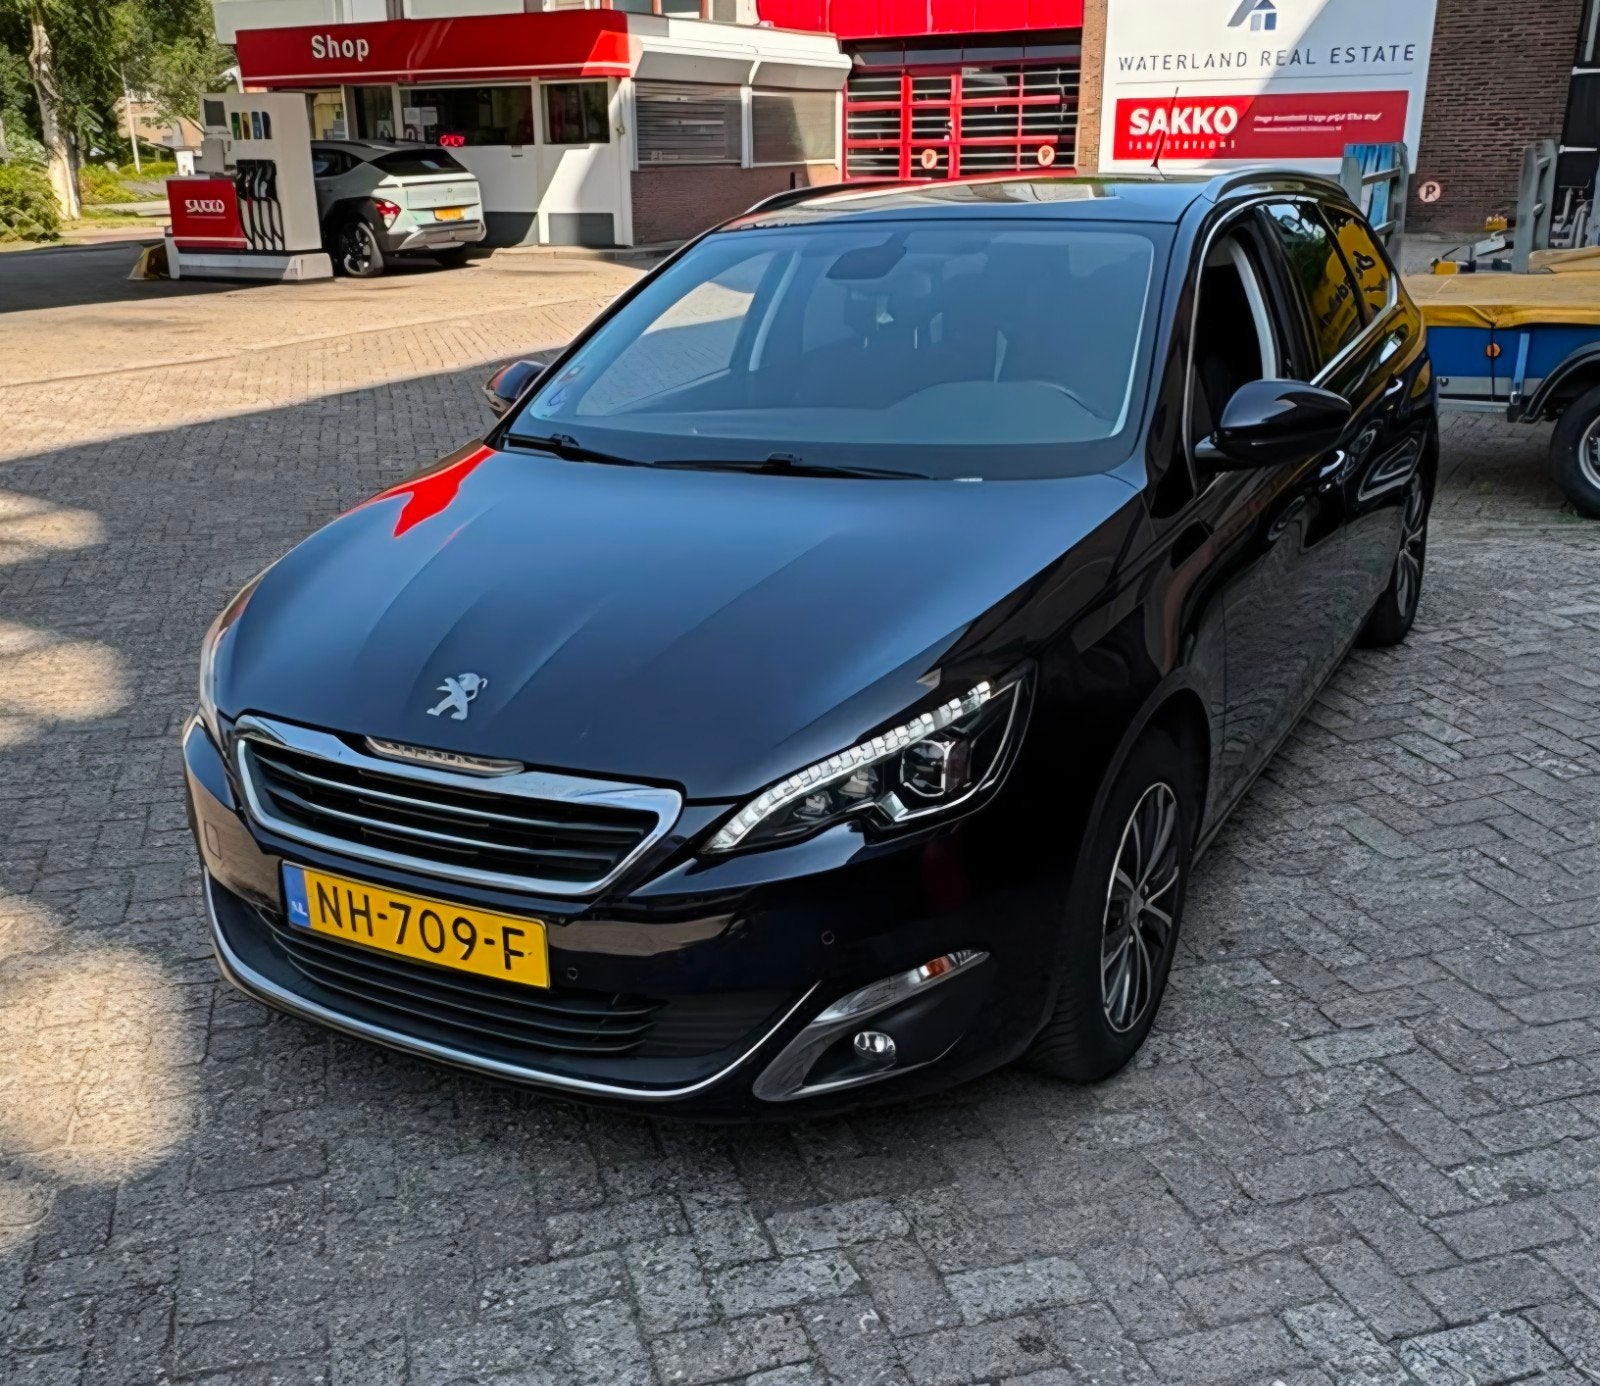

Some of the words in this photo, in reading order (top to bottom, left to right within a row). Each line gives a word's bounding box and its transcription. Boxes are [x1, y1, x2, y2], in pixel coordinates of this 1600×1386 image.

[311, 34, 370, 62] Shop
[1118, 51, 1248, 72] WATERLAND
[1260, 49, 1316, 67] REAL
[1329, 43, 1416, 65] ESTATE
[1129, 105, 1238, 136] SAKKO
[315, 880, 525, 971] NH-709-F
